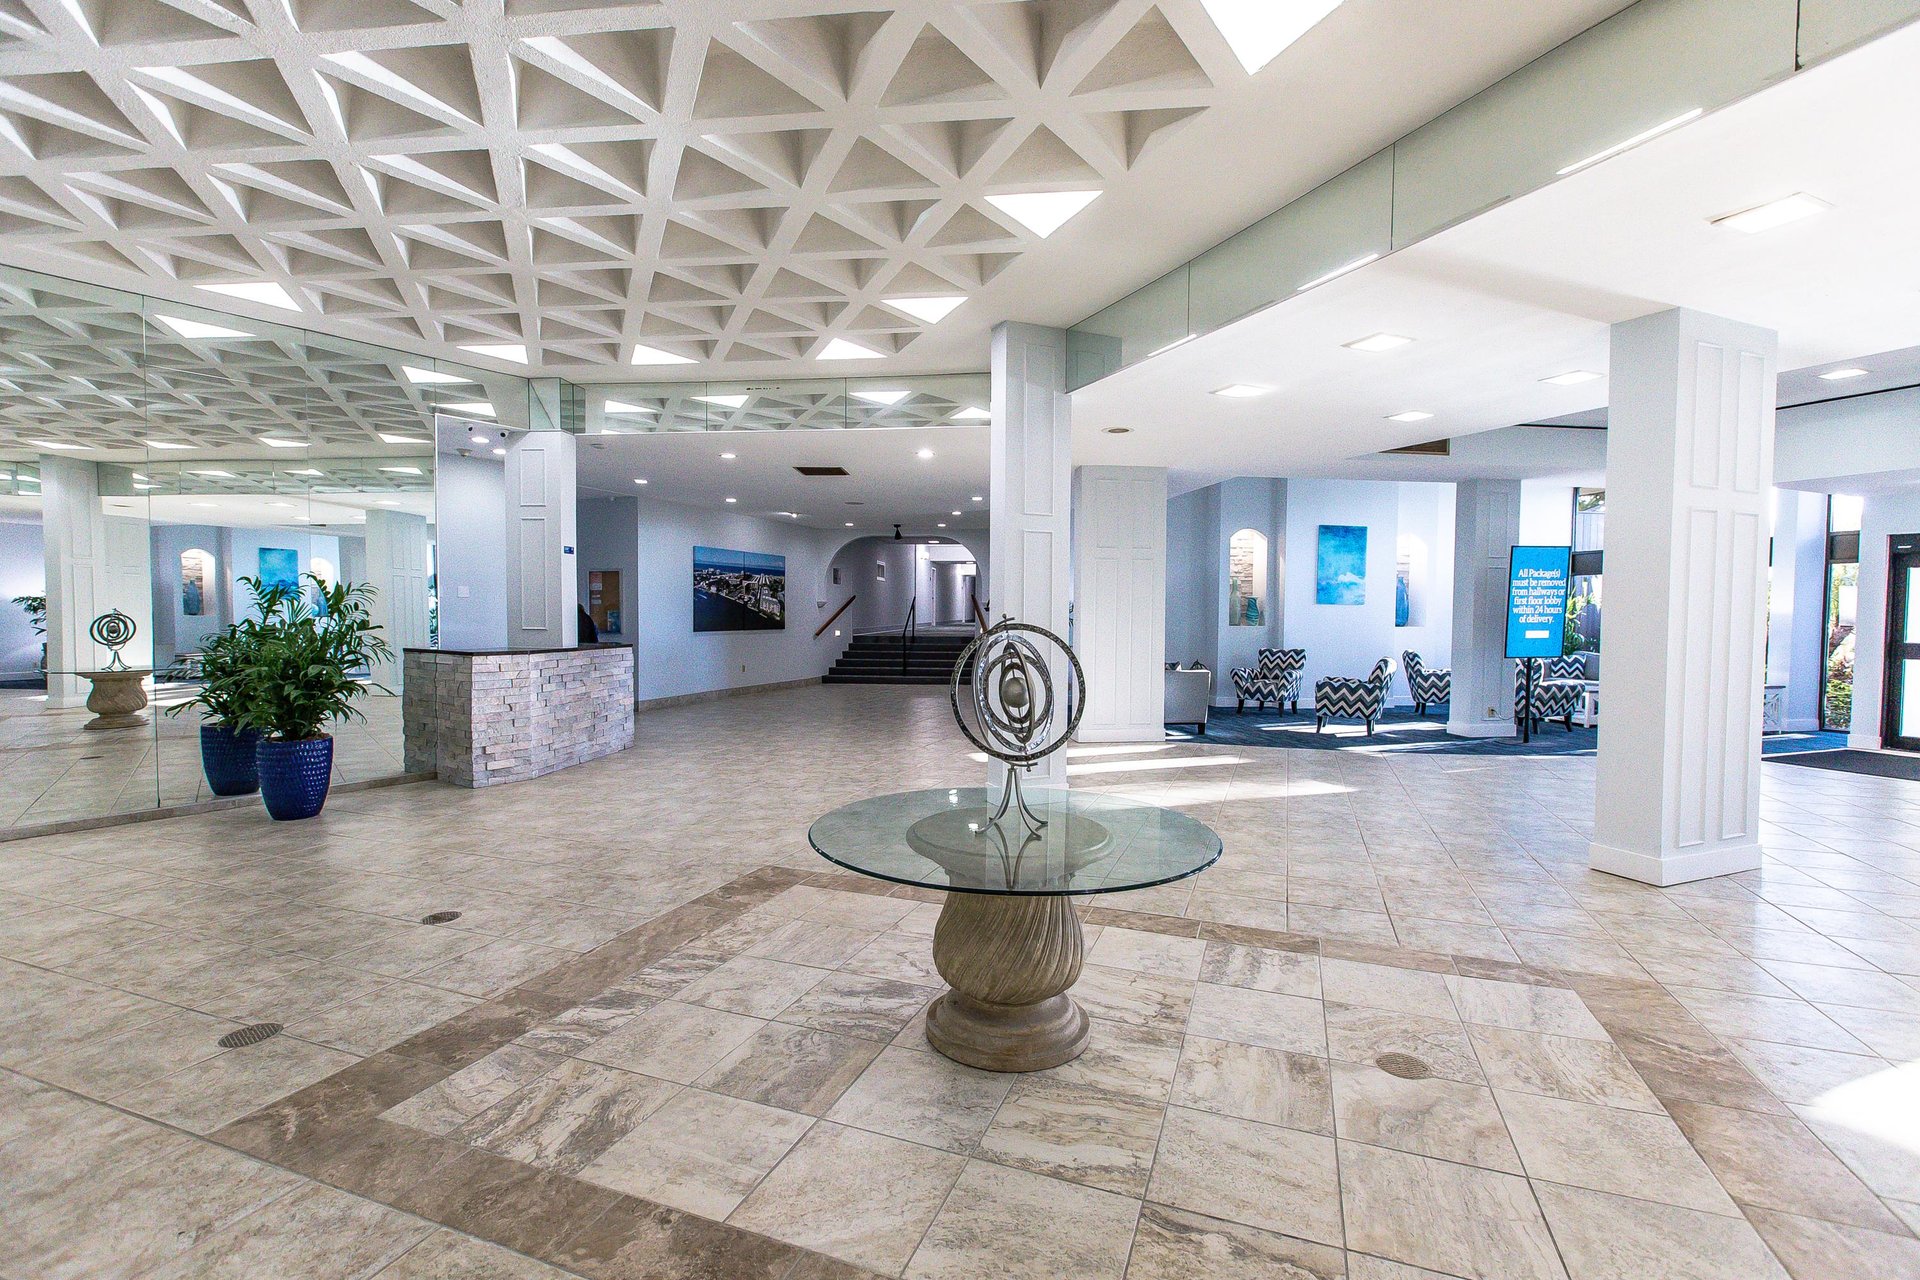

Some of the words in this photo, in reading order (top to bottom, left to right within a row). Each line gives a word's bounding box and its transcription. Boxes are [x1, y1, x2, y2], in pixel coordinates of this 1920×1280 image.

[1518, 568, 1528, 577] All
[1530, 578, 1538, 586] be
[1538, 578, 1566, 586] removed
[1512, 588, 1528, 596] from
[1529, 587, 1558, 596] hallways
[1514, 597, 1528, 605] first
[1528, 597, 1543, 605] floor
[1544, 596, 1562, 606] lobby
[1513, 606, 1534, 614] within
[1535, 606, 1543, 614] 24
[1519, 615, 1526, 623] of
[1527, 615, 1554, 624] delivery.
